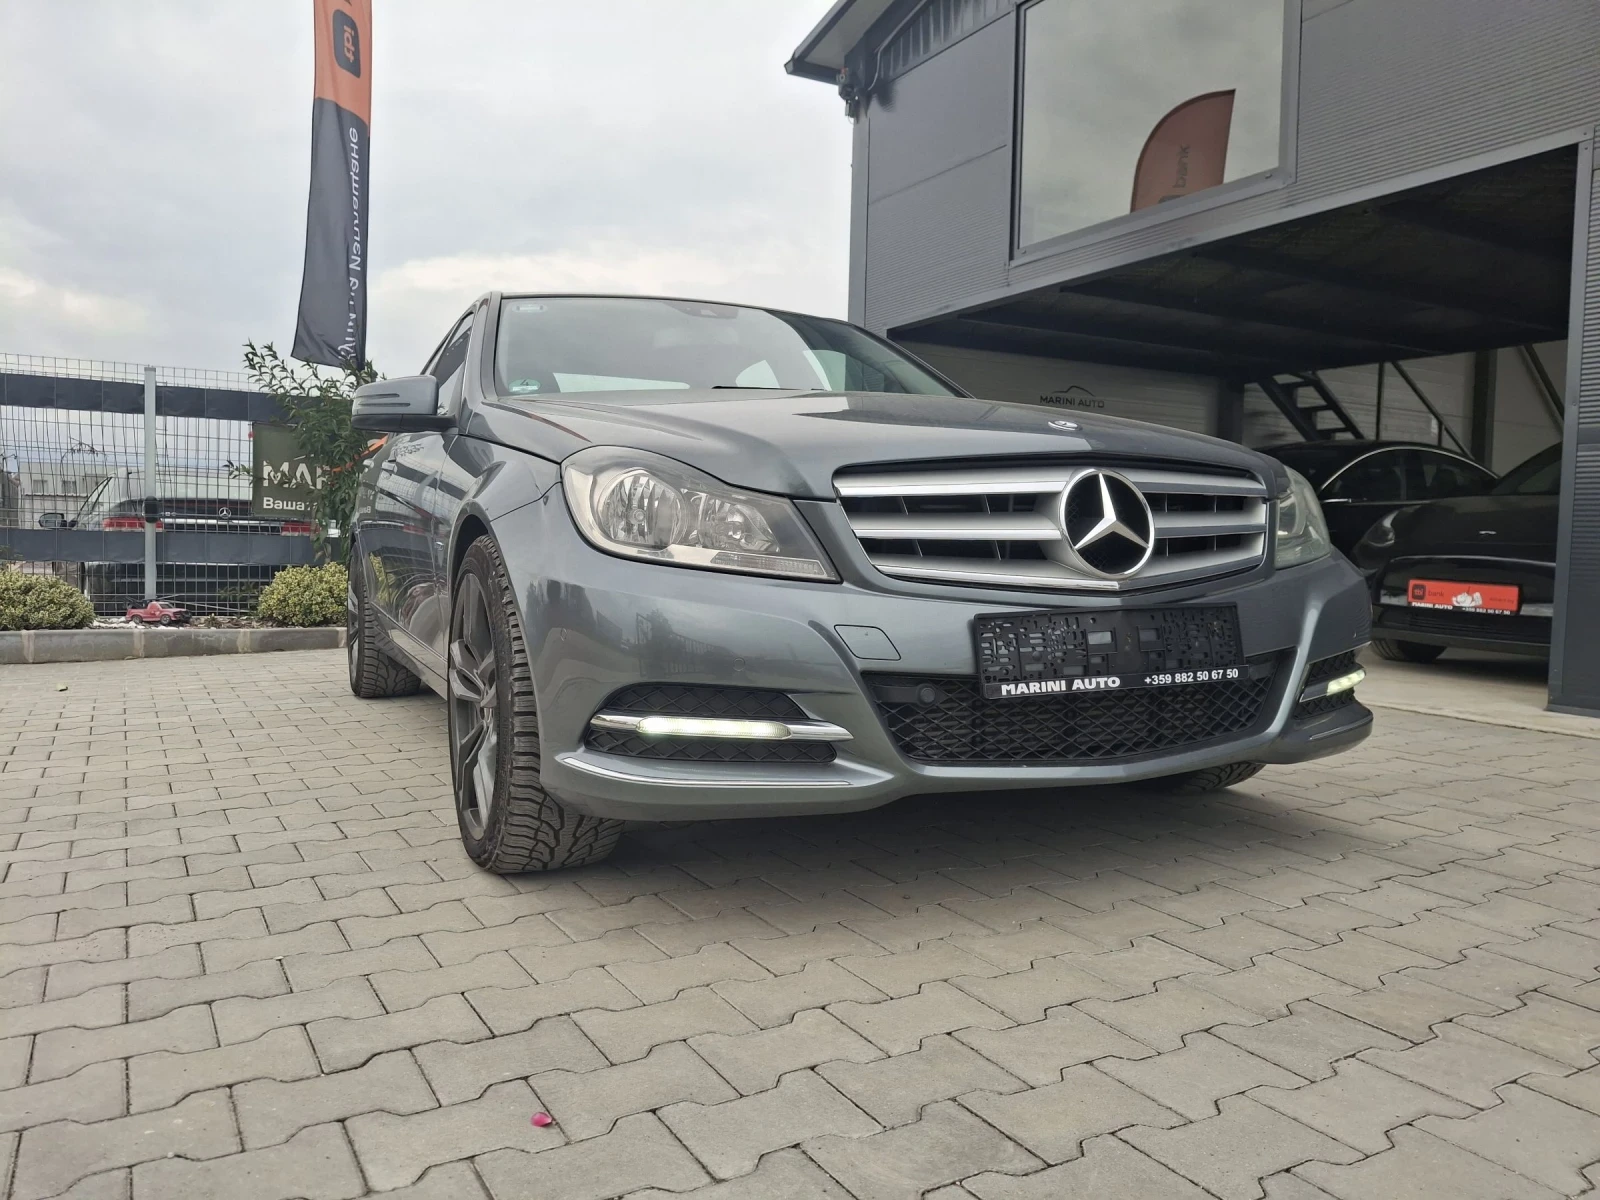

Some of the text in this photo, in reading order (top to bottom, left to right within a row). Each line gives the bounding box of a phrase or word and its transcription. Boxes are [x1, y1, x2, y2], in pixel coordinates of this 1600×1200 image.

[1039, 395, 1105, 409] MARINI AUTO
[1434, 603, 1453, 611] AUTO
[1001, 668, 1239, 696] MARINI AUTO +359 882 50 67 50
